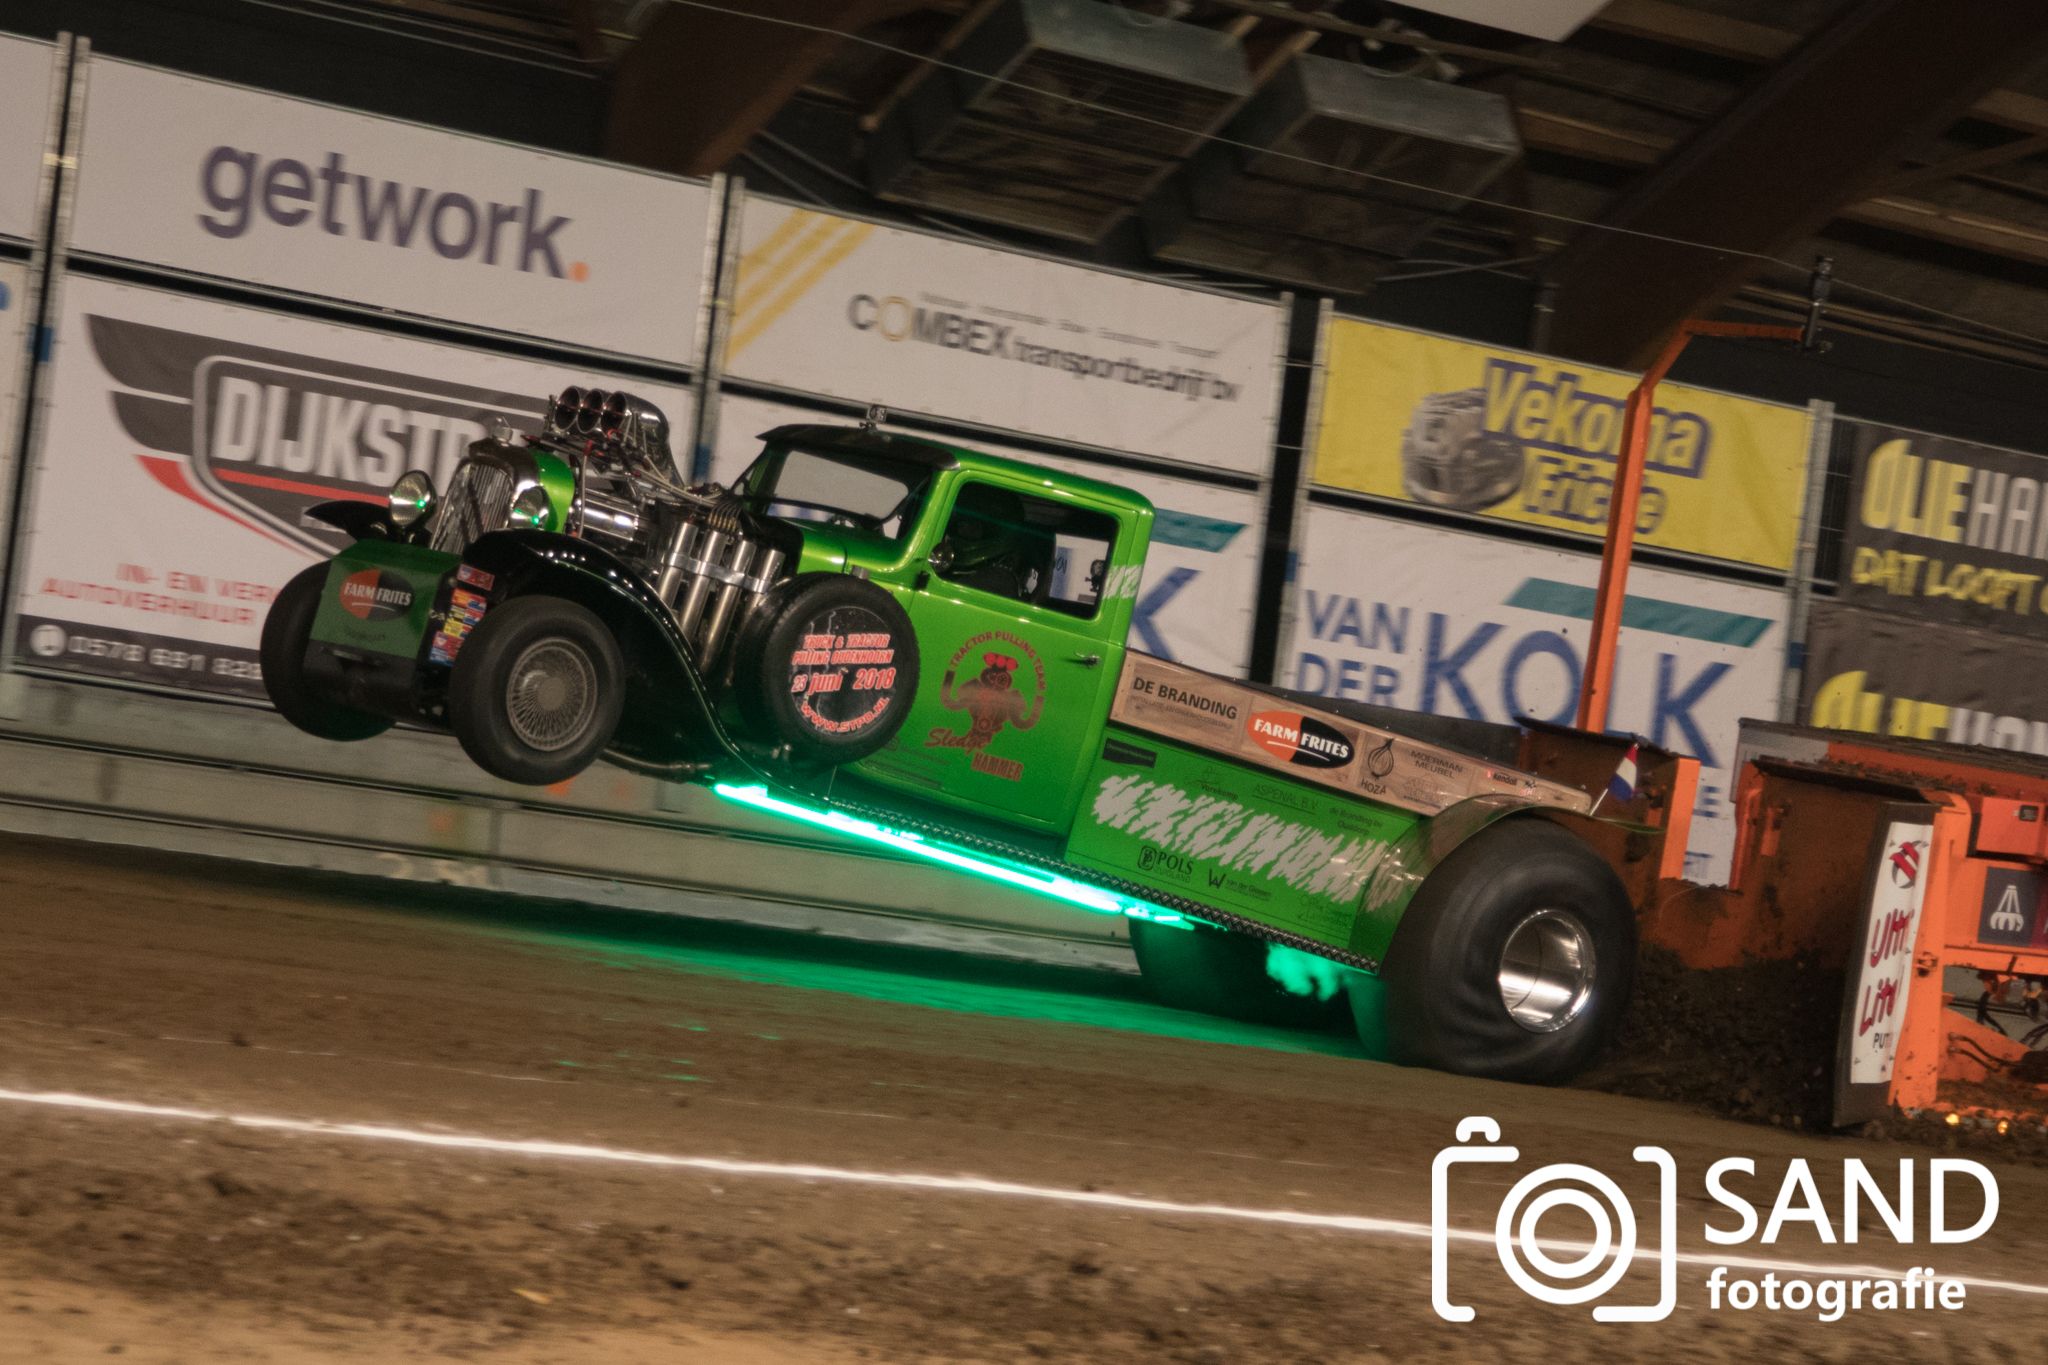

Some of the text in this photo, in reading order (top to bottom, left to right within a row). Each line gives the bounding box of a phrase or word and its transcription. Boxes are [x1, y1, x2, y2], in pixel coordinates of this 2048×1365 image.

[197, 144, 590, 283] getwork.
[846, 293, 1013, 359] COMBEX
[166, 571, 208, 594] EN
[1853, 546, 1925, 597] DAT
[40, 577, 257, 625] AUTOVERHUUR
[344, 582, 412, 606] FARM FRITES
[1303, 588, 1409, 654] VAN
[803, 634, 836, 649] TRUCK
[846, 633, 891, 648] TRACTOR
[951, 630, 1047, 690] TRACTOR PULLING TEAM
[807, 670, 843, 696] juni
[852, 667, 896, 690] 2018
[1298, 651, 1401, 706] DER
[1132, 676, 1154, 695] DE
[1158, 684, 1238, 720] BRANDING
[924, 727, 993, 757] Sledge
[1254, 718, 1349, 759] FARM FRITES
[971, 751, 1024, 783] HAMMER
[1411, 750, 1463, 773] MOERMAN
[1415, 760, 1454, 779] MEUBEL
[1156, 850, 1194, 876] POLS
